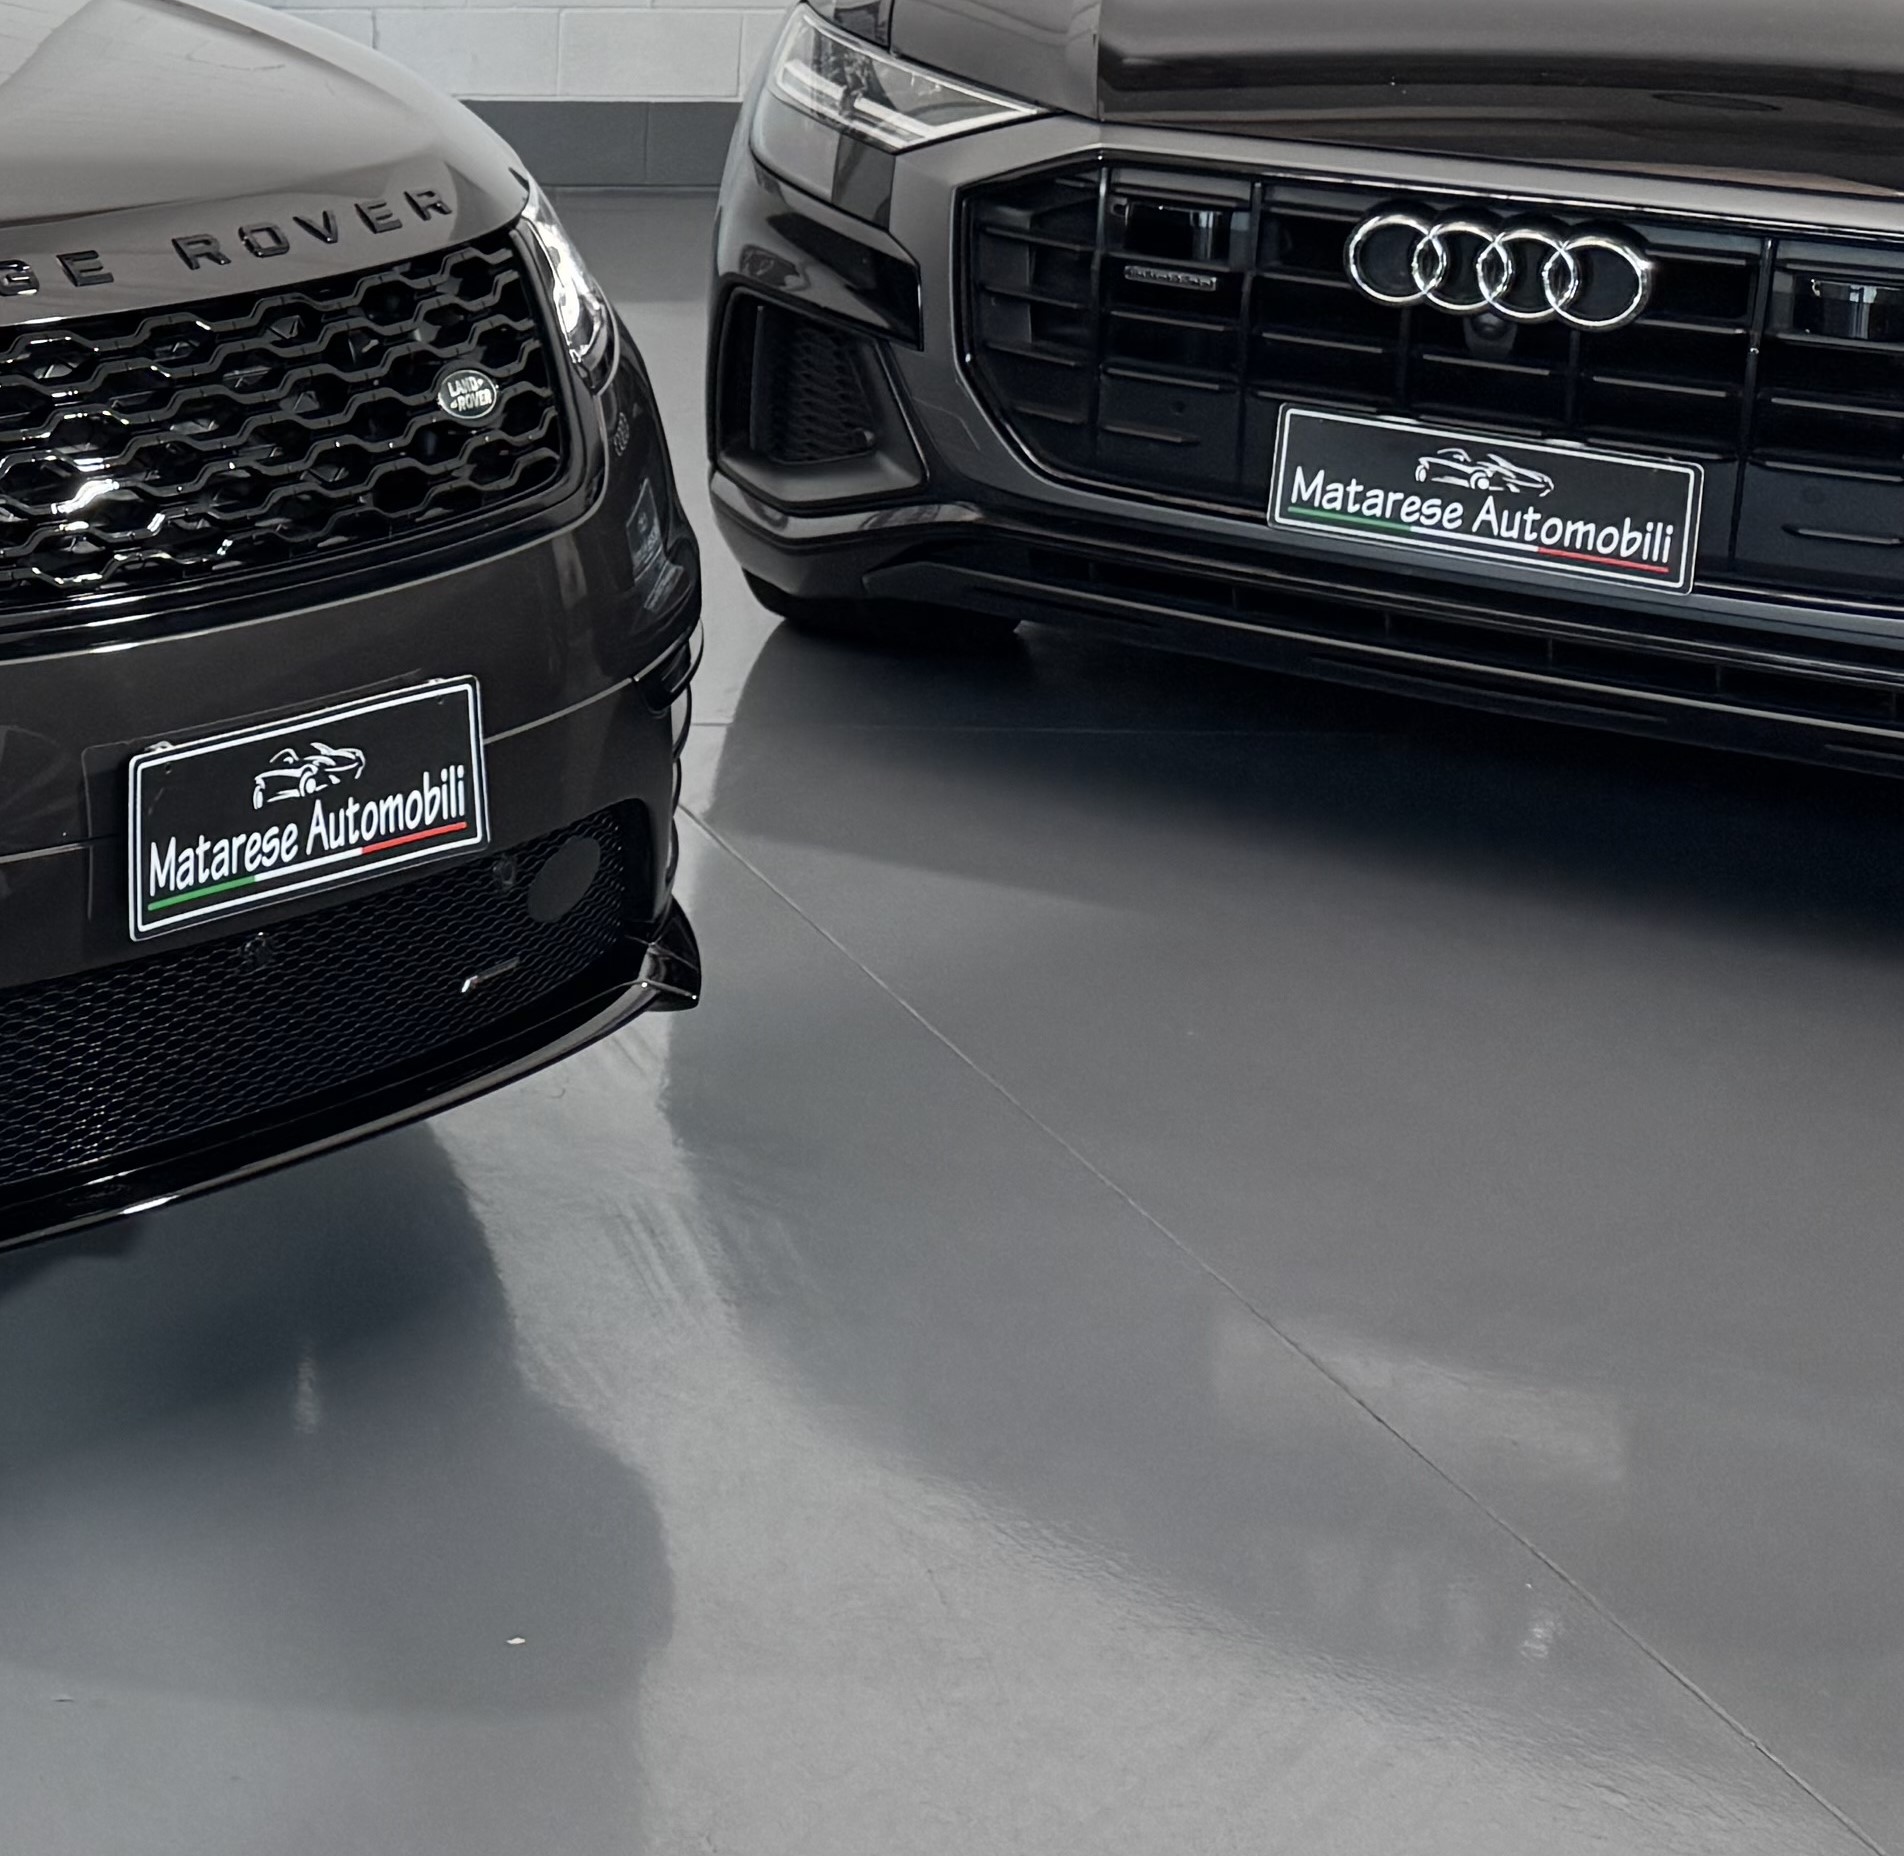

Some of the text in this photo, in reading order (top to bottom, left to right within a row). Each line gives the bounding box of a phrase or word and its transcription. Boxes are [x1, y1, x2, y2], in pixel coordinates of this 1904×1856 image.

[170, 186, 454, 270] ROVER
[447, 375, 479, 398] LAND
[457, 388, 493, 412] ROVER
[1290, 465, 1674, 564] Matarese Automobili
[149, 764, 465, 897] Matarese Automobili
